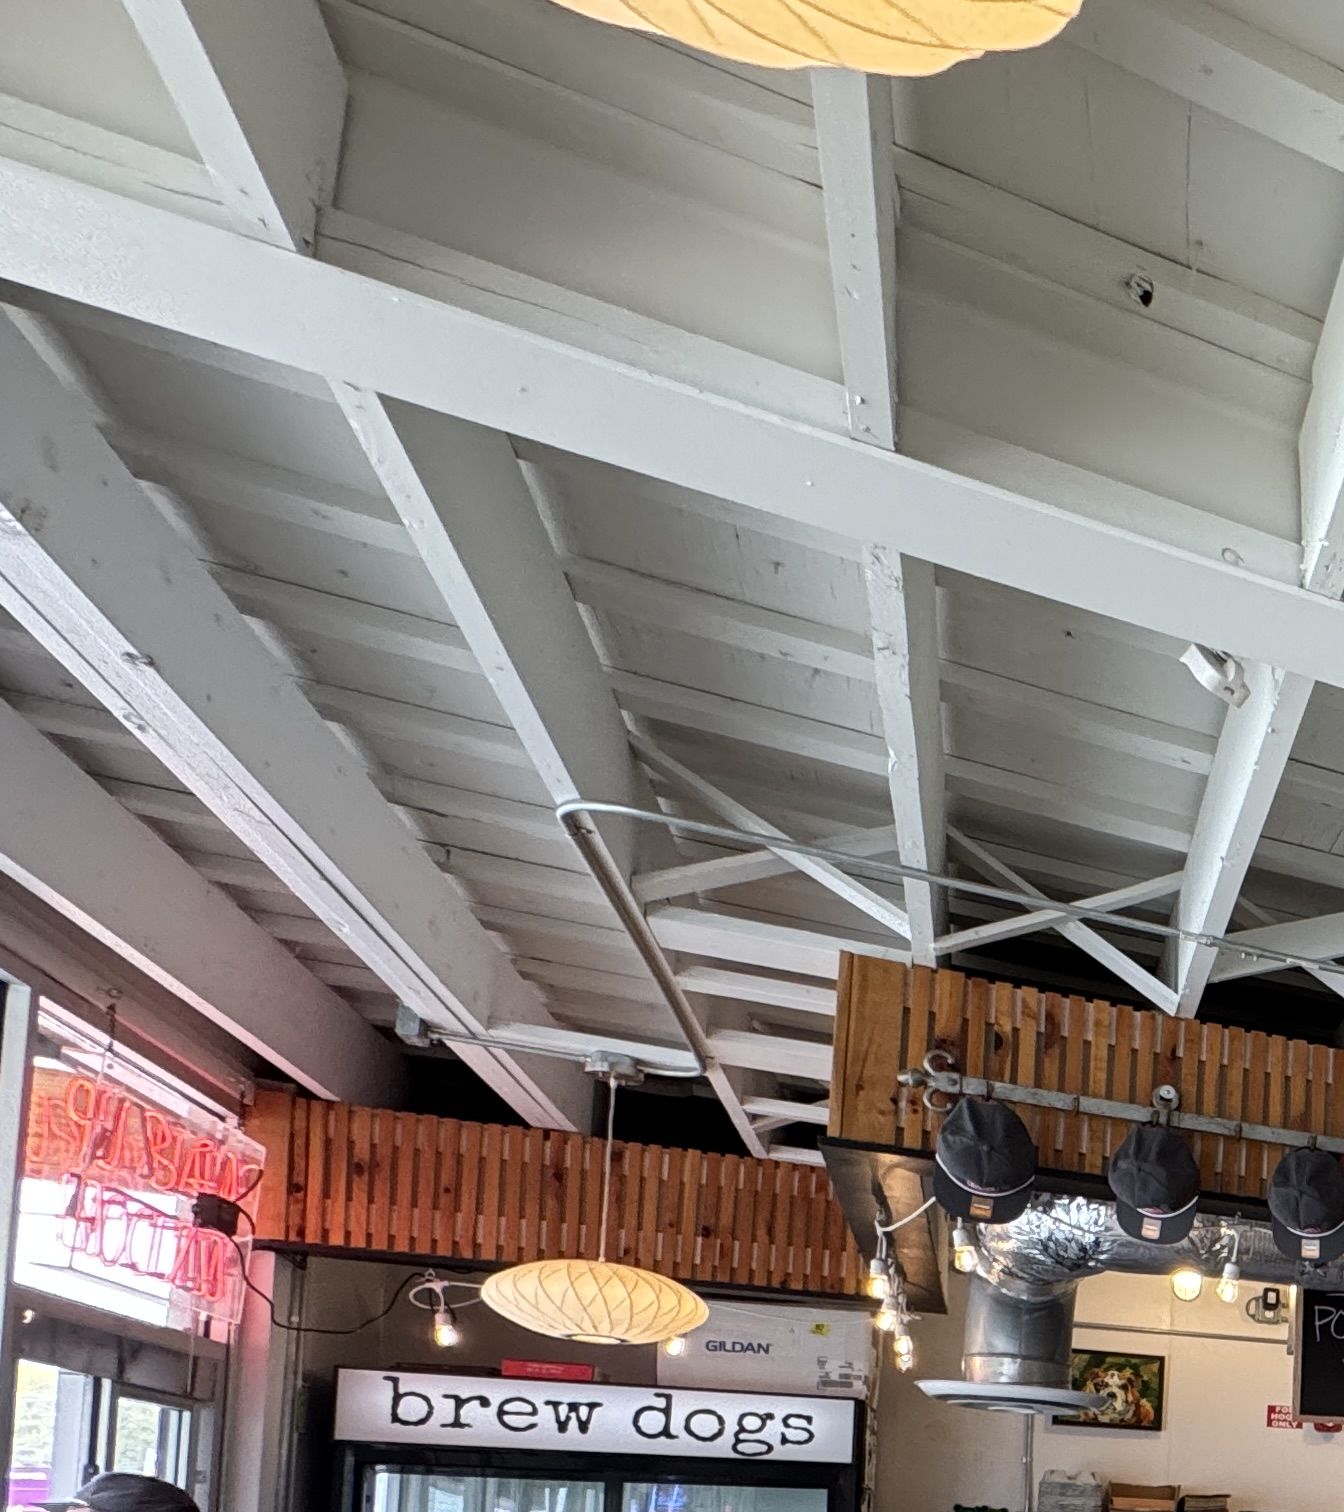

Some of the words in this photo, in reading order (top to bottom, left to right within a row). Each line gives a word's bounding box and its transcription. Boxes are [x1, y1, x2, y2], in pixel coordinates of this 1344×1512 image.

[705, 1339, 770, 1355] GILDAN
[389, 1377, 603, 1437] brew
[632, 1392, 817, 1457] dogs
